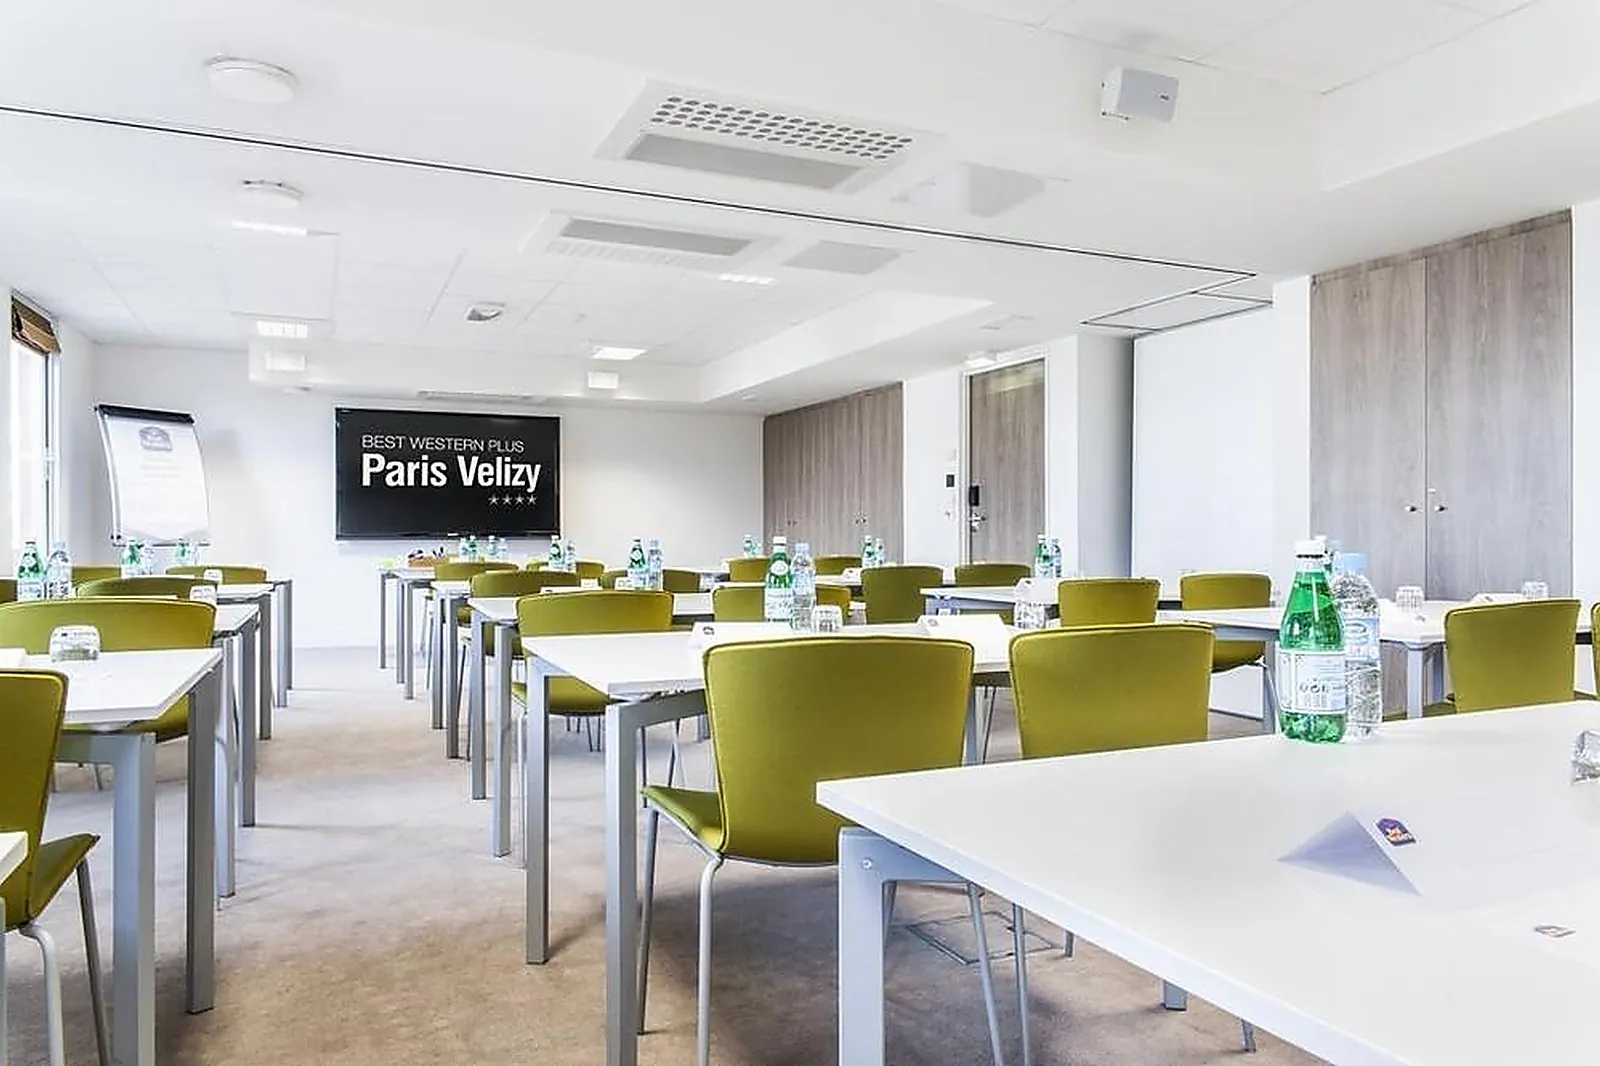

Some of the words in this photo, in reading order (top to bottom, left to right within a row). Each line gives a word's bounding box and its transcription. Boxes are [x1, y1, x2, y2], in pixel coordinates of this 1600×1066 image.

[361, 434, 405, 450] BEST
[409, 436, 485, 452] WESTERN
[488, 439, 525, 453] PLUS
[362, 453, 448, 487] Paris
[457, 455, 542, 493] Velizy
